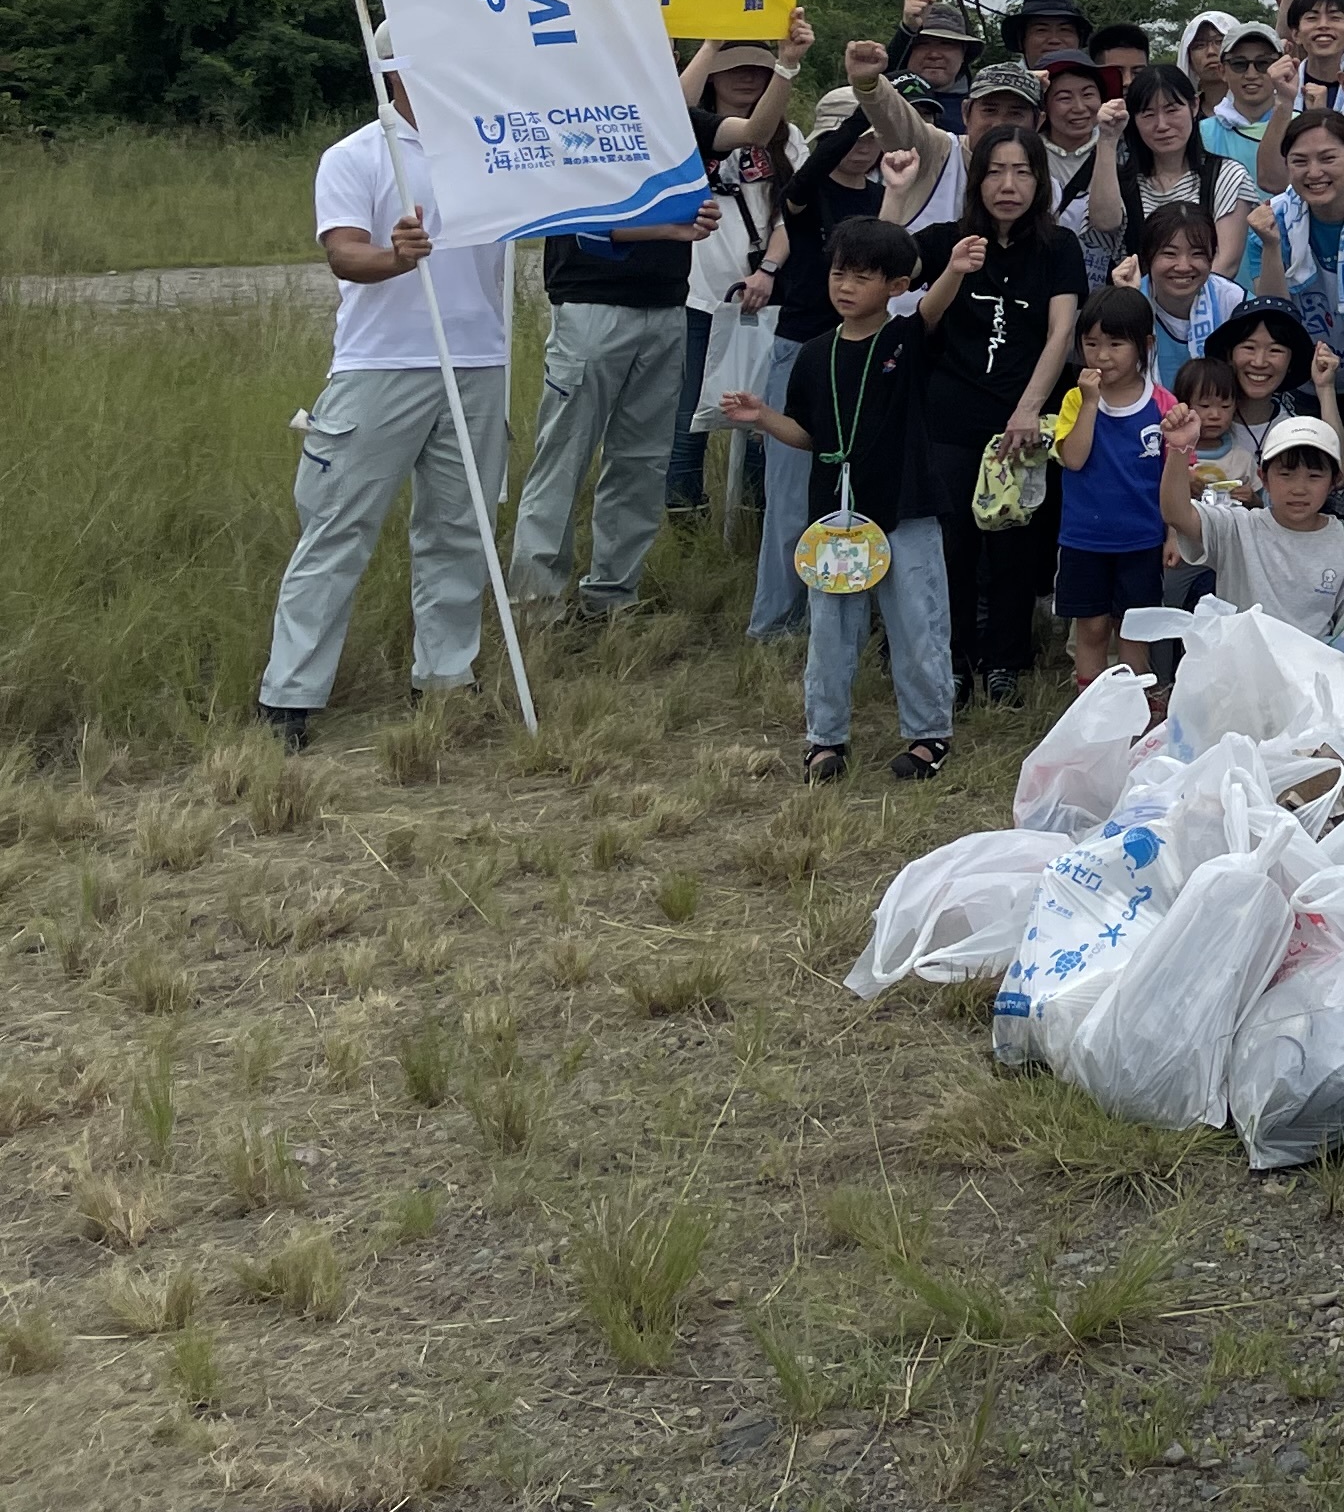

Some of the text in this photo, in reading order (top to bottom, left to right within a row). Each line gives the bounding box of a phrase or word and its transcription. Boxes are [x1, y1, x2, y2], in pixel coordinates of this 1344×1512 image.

[508, 111, 542, 127] 日本
[548, 104, 641, 125] CHANGE
[596, 122, 643, 135] FOR THE
[599, 134, 649, 153] BLUE
[485, 145, 554, 174] 海と日本
